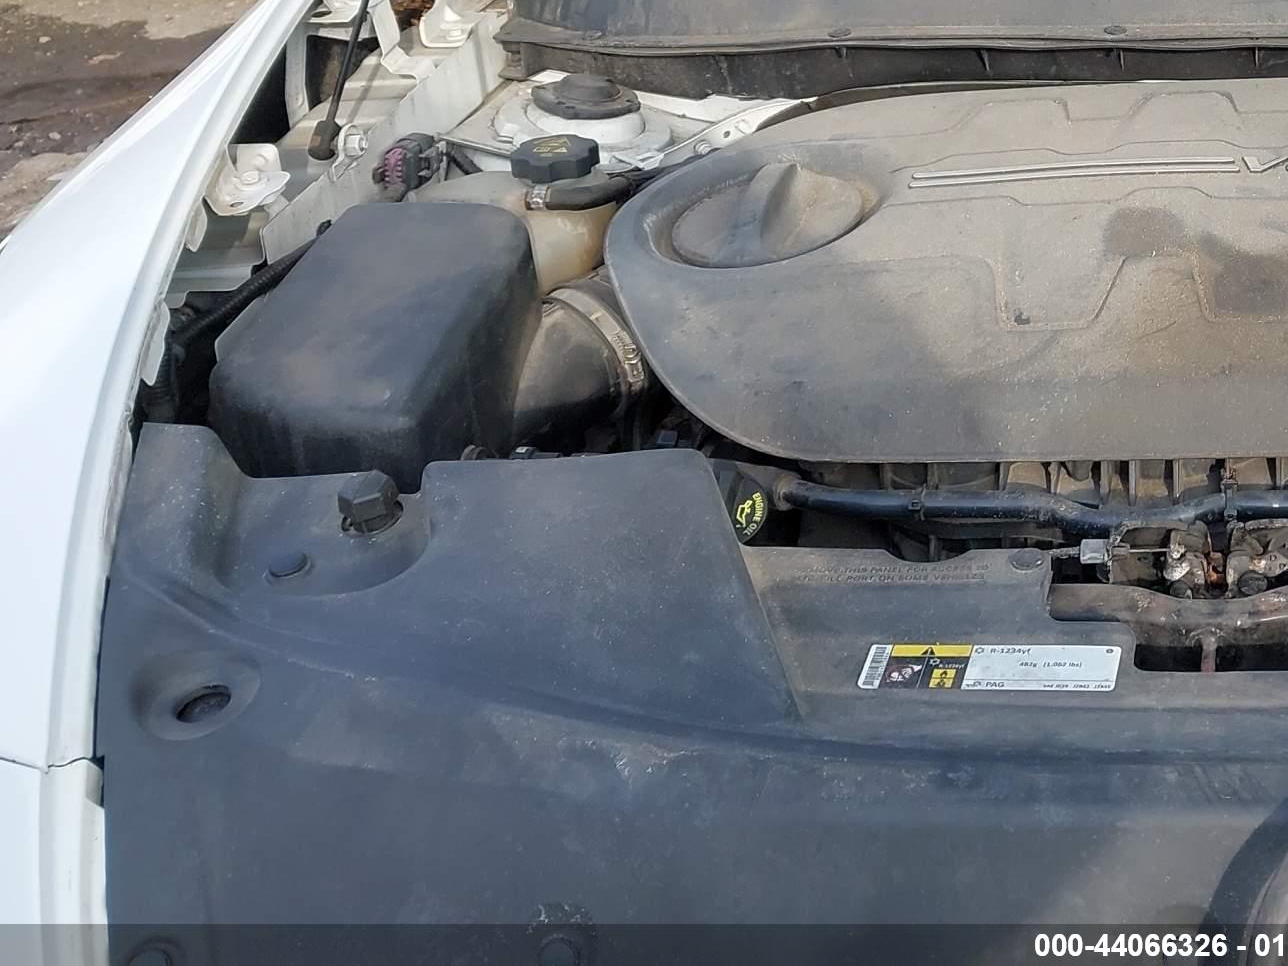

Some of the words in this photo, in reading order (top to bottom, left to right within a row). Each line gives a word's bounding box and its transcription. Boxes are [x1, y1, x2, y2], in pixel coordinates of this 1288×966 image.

[752, 491, 764, 522] ENGINE
[742, 522, 758, 536] OIL
[990, 647, 1032, 655] R-1234yf
